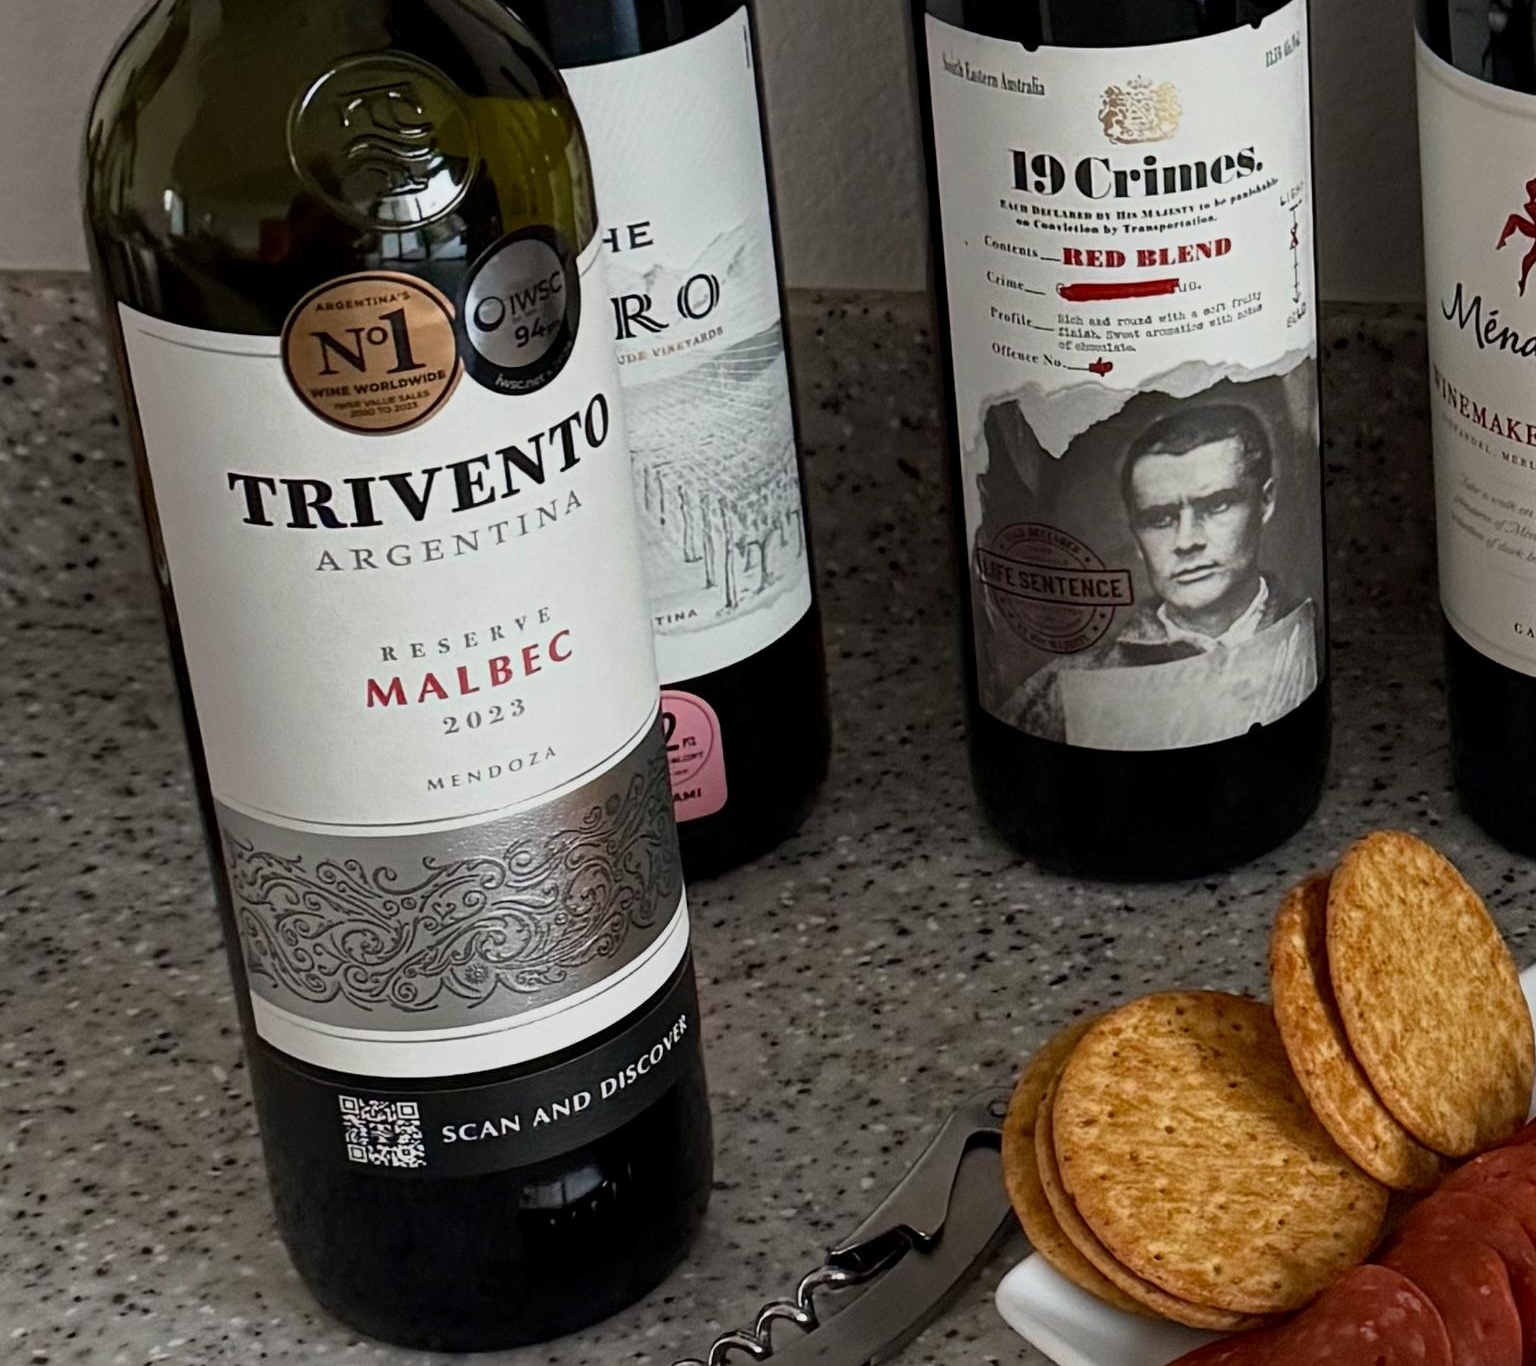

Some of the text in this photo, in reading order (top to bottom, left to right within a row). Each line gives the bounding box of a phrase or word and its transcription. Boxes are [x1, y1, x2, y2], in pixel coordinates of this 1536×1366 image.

[1001, 71, 1046, 96] Australia
[1008, 148, 1066, 196] 19
[1033, 218, 1099, 235] Conviction
[1103, 225, 1118, 237] by
[984, 235, 1233, 268] Contents RED BLEND
[509, 271, 563, 316] IWSC
[986, 270, 1025, 293] Crime
[315, 290, 412, 313] ARGENTINA'S
[990, 306, 1033, 328] Profile
[1158, 308, 1186, 324] with
[515, 318, 546, 349] 94
[1209, 314, 1233, 328] with
[652, 325, 724, 358] VINEYARDS
[991, 342, 1040, 364] Offence
[1058, 340, 1072, 350] of
[310, 370, 447, 399] WINE WORLDWIDE
[227, 392, 610, 530] TRIVENTO
[315, 489, 583, 572] ARGENTINA
[983, 558, 1123, 598] LIFE SENTENCE
[380, 606, 553, 664] RESERVE
[366, 629, 574, 708] MALBEC
[442, 697, 526, 736] 2023
[426, 745, 559, 793] MENDOZA
[442, 1014, 687, 1144] SCAN AND DISCOVER
